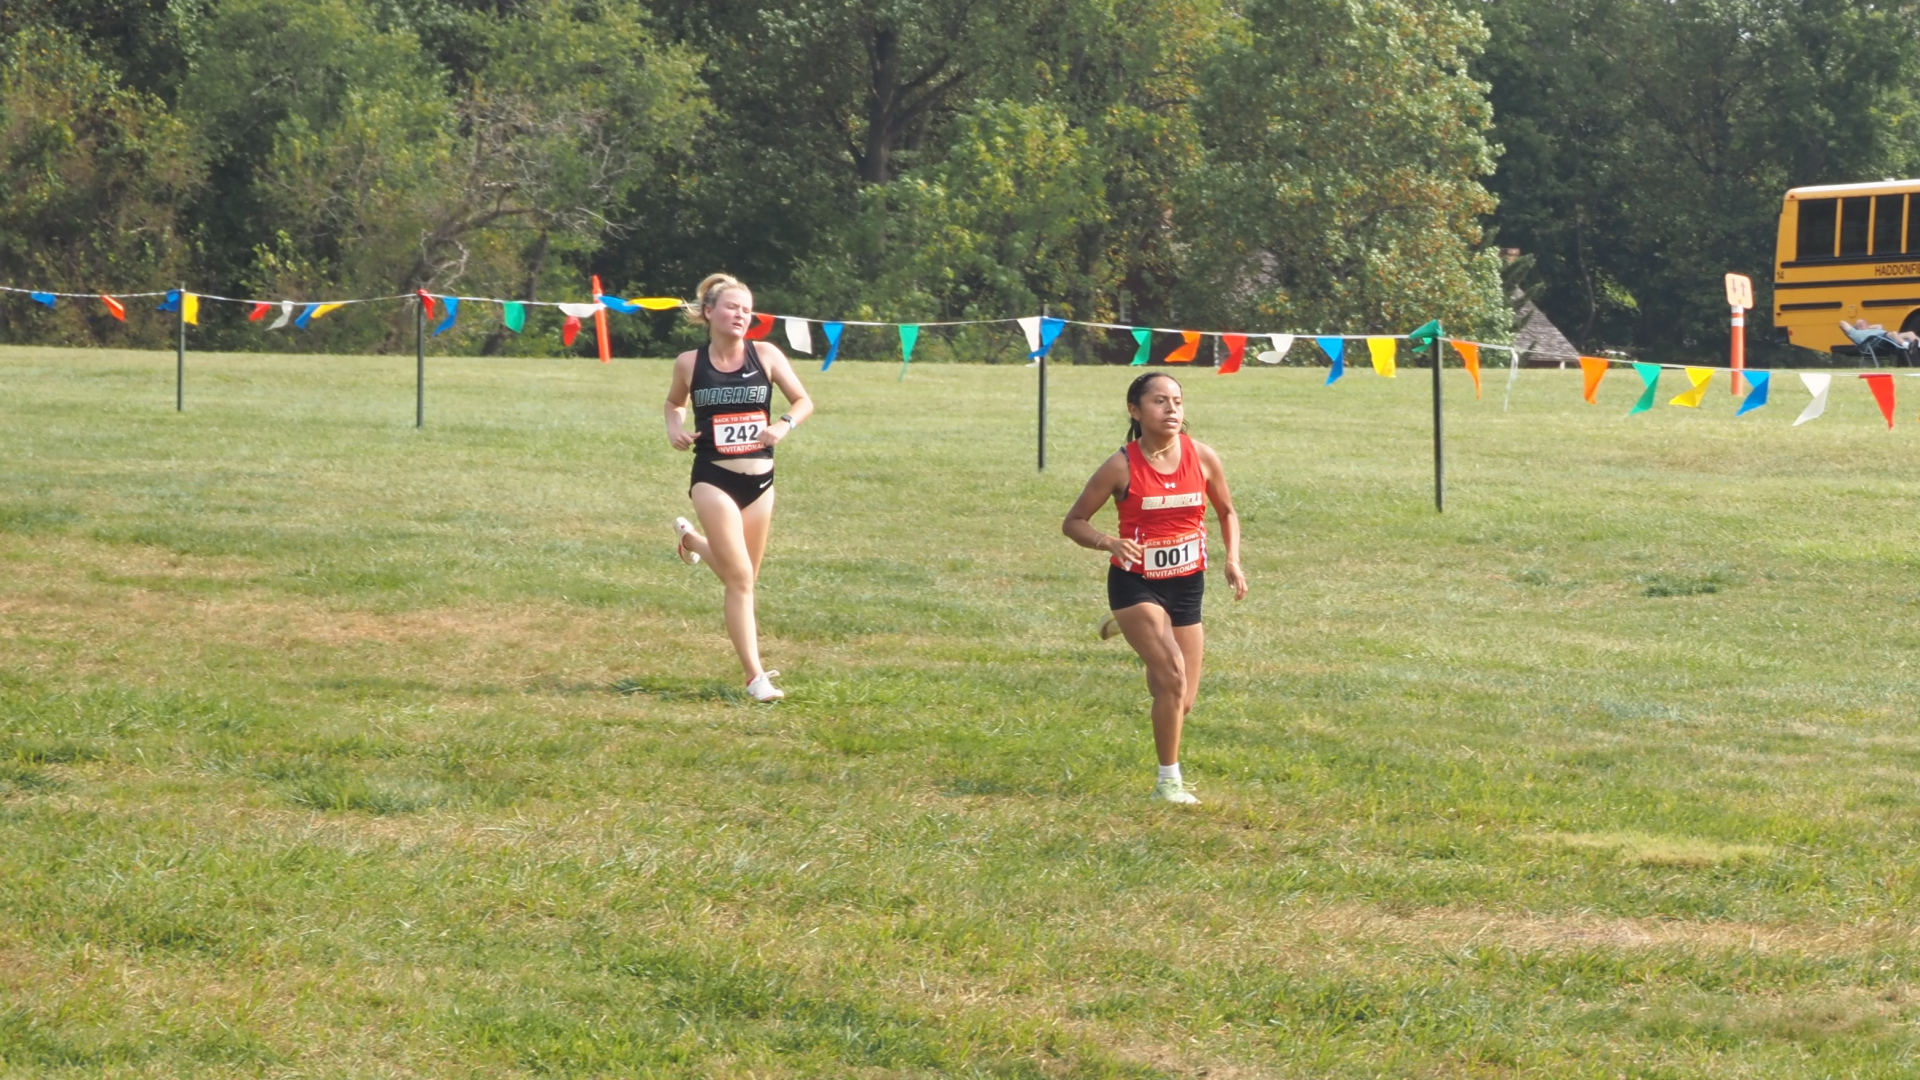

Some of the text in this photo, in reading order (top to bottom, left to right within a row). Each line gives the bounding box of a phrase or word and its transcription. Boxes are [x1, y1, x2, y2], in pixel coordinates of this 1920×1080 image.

[694, 385, 767, 407] WAGNER
[723, 424, 758, 443] 242
[718, 443, 765, 453] INVITATIONAL
[1172, 536, 1184, 545] THE
[1154, 543, 1189, 568] 001
[1146, 561, 1198, 578] INVITATIONAL
